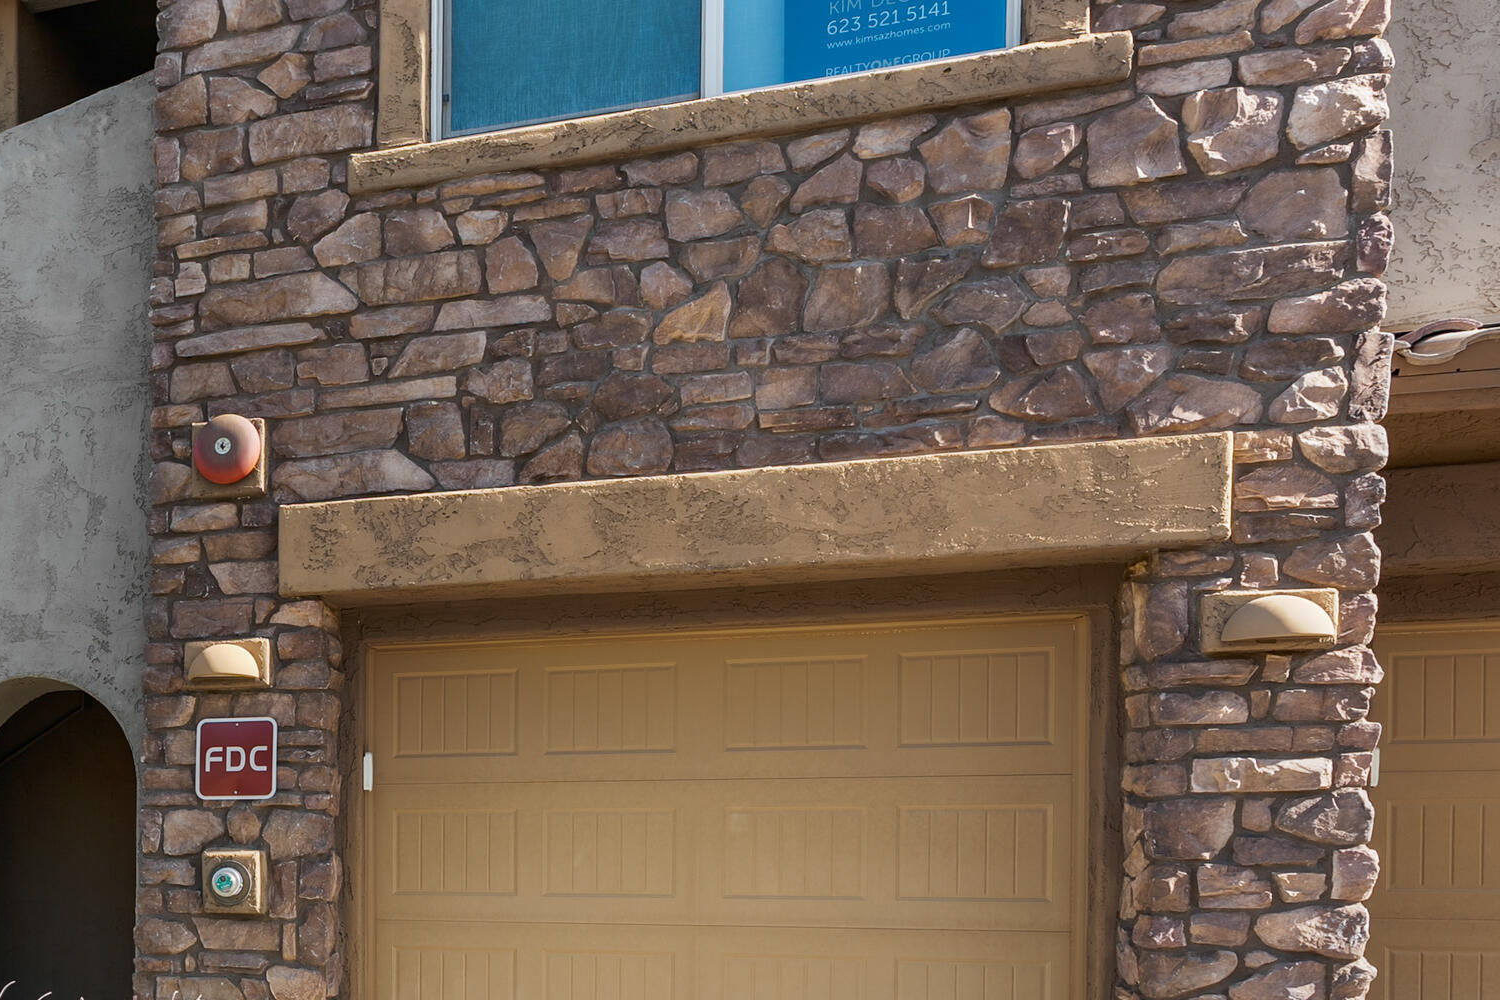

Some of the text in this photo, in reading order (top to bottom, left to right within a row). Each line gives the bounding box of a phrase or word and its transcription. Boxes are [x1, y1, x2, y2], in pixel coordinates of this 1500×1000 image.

[829, 0, 862, 15] KIM
[826, 22, 951, 49] www.kimsazhomes.com
[205, 745, 268, 772] FDC
